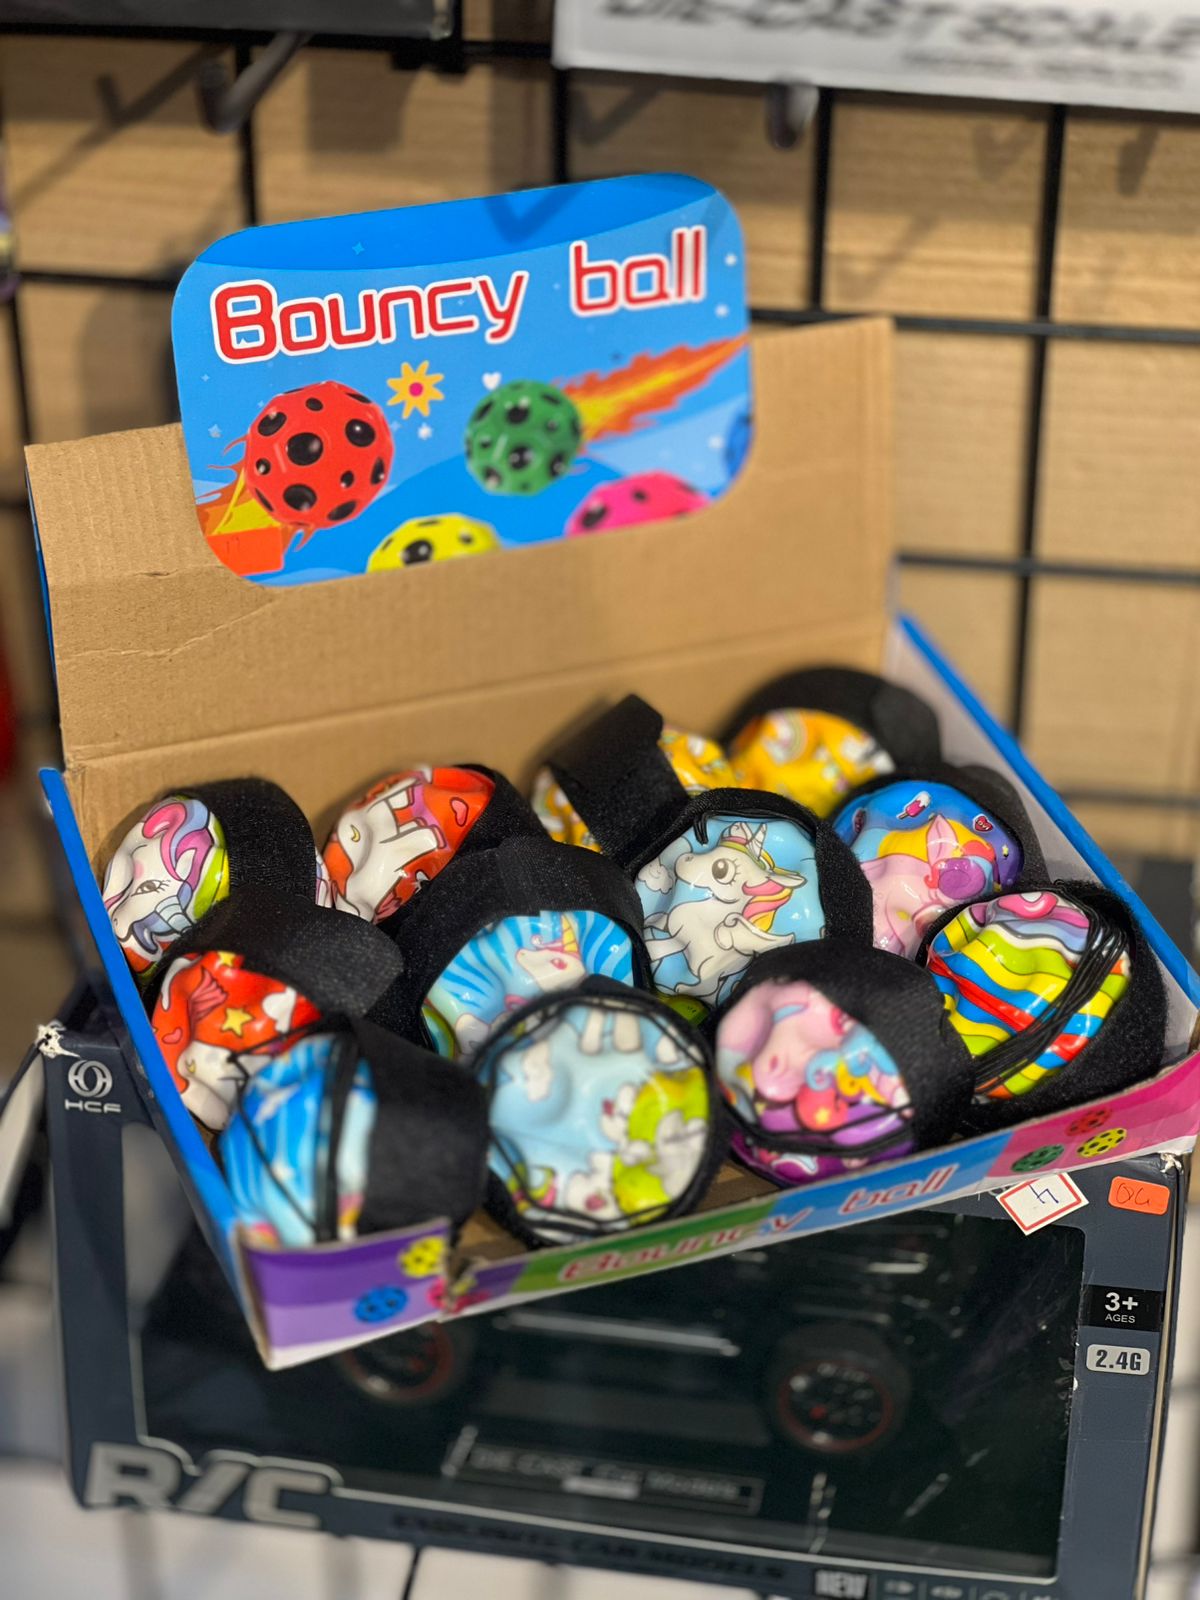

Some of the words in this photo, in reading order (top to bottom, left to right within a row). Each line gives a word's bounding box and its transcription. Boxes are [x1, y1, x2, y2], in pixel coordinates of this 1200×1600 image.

[209, 271, 529, 364] Bouncy
[569, 225, 708, 316] ball
[64, 1099, 121, 1113] HCF
[837, 1164, 958, 1216] ball
[1104, 1292, 1139, 1312] 3+
[1105, 1313, 1136, 1323] AGES
[1095, 1349, 1142, 1371] 2.4G
[85, 1442, 329, 1529] R/C
[814, 1569, 868, 1599] NEW
